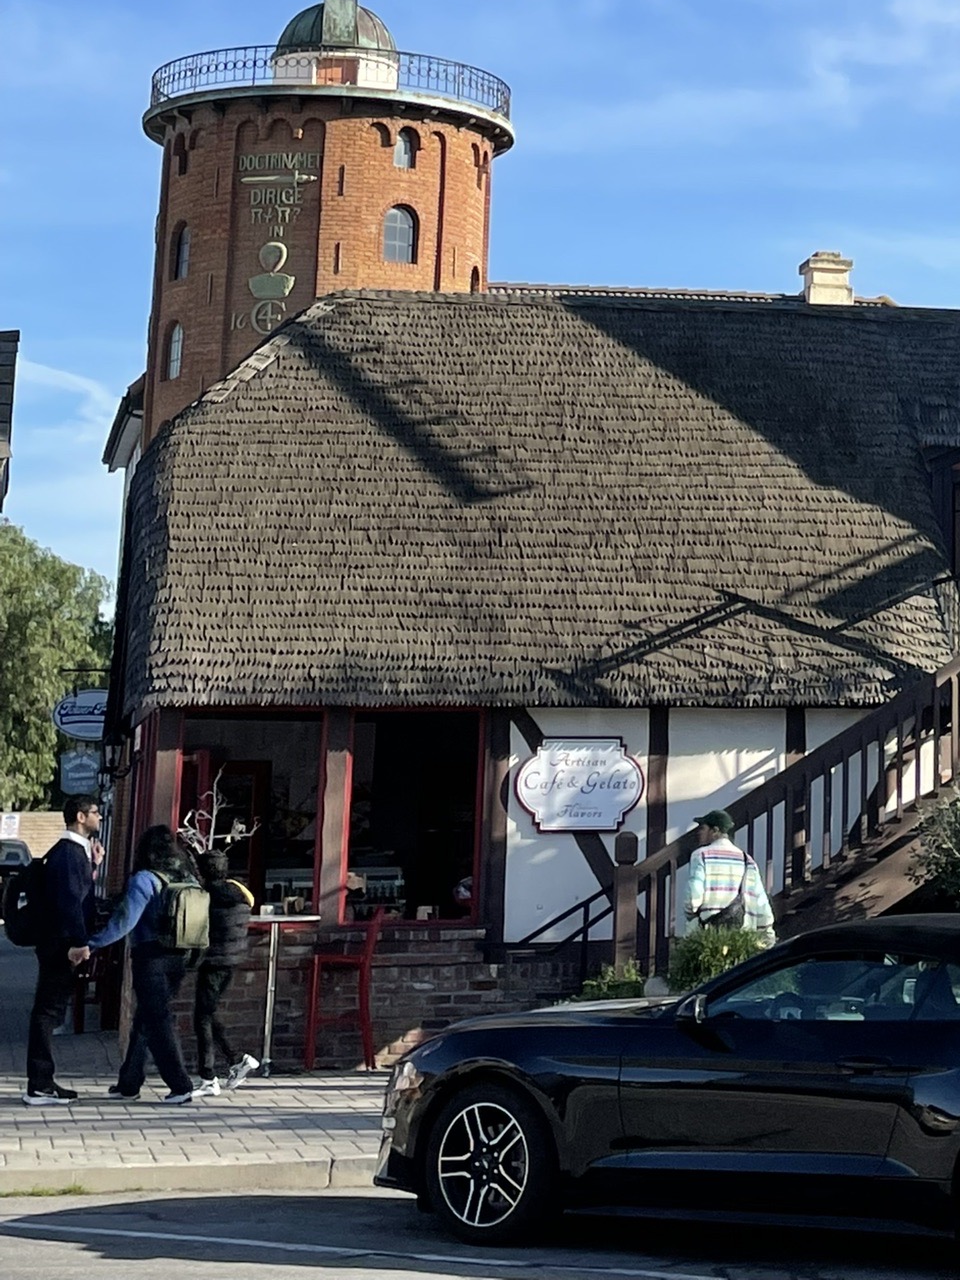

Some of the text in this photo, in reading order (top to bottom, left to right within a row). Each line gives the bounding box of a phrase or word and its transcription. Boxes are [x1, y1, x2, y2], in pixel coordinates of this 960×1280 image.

[250, 187, 305, 206] DIRIGE
[269, 226, 283, 237] IN
[549, 752, 607, 767] Artisan
[567, 776, 579, 788] &
[580, 769, 637, 794] Gelato
[556, 803, 603, 819] Flavors
